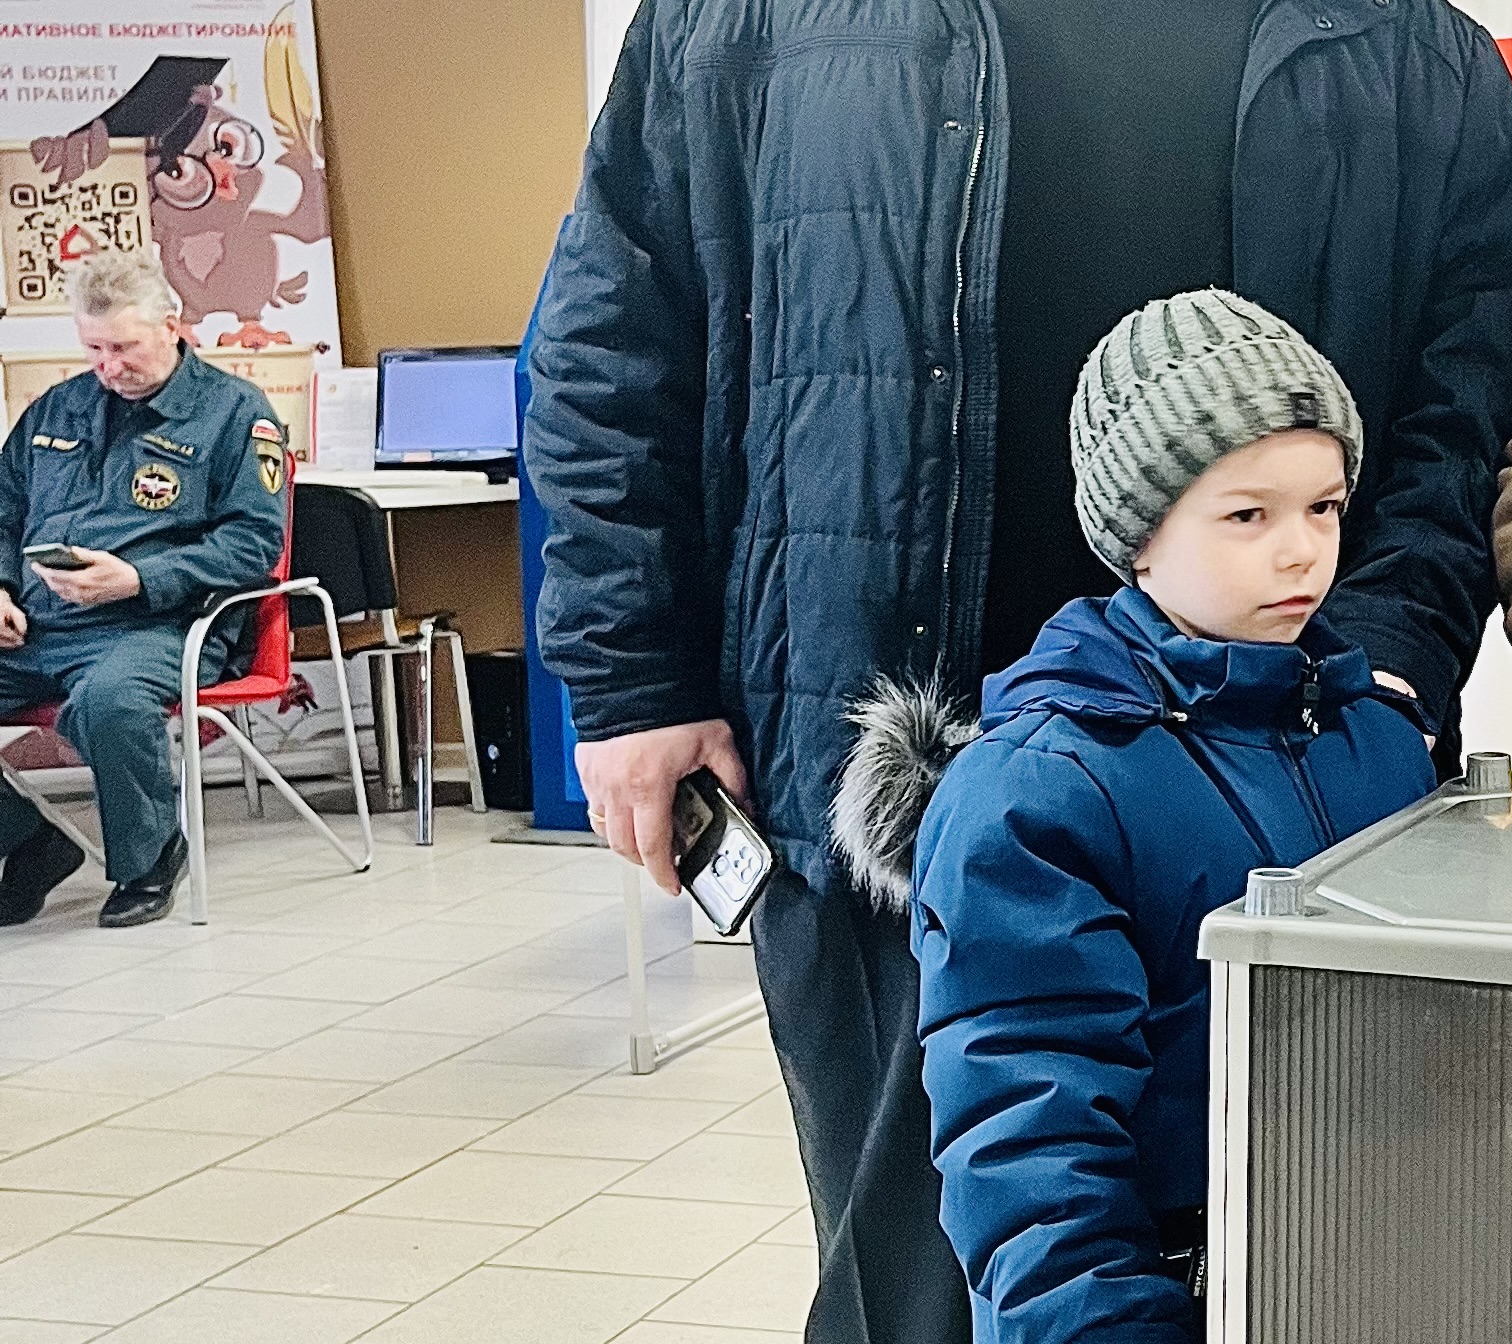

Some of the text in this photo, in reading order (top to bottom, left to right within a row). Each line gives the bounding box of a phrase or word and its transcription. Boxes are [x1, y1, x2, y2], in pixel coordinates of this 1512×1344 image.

[109, 22, 297, 39] БЮДЖЕТИРОВАНИЕ
[22, 64, 118, 82] БЮДЖЕТ
[17, 86, 125, 103] ПРАВИЛА
